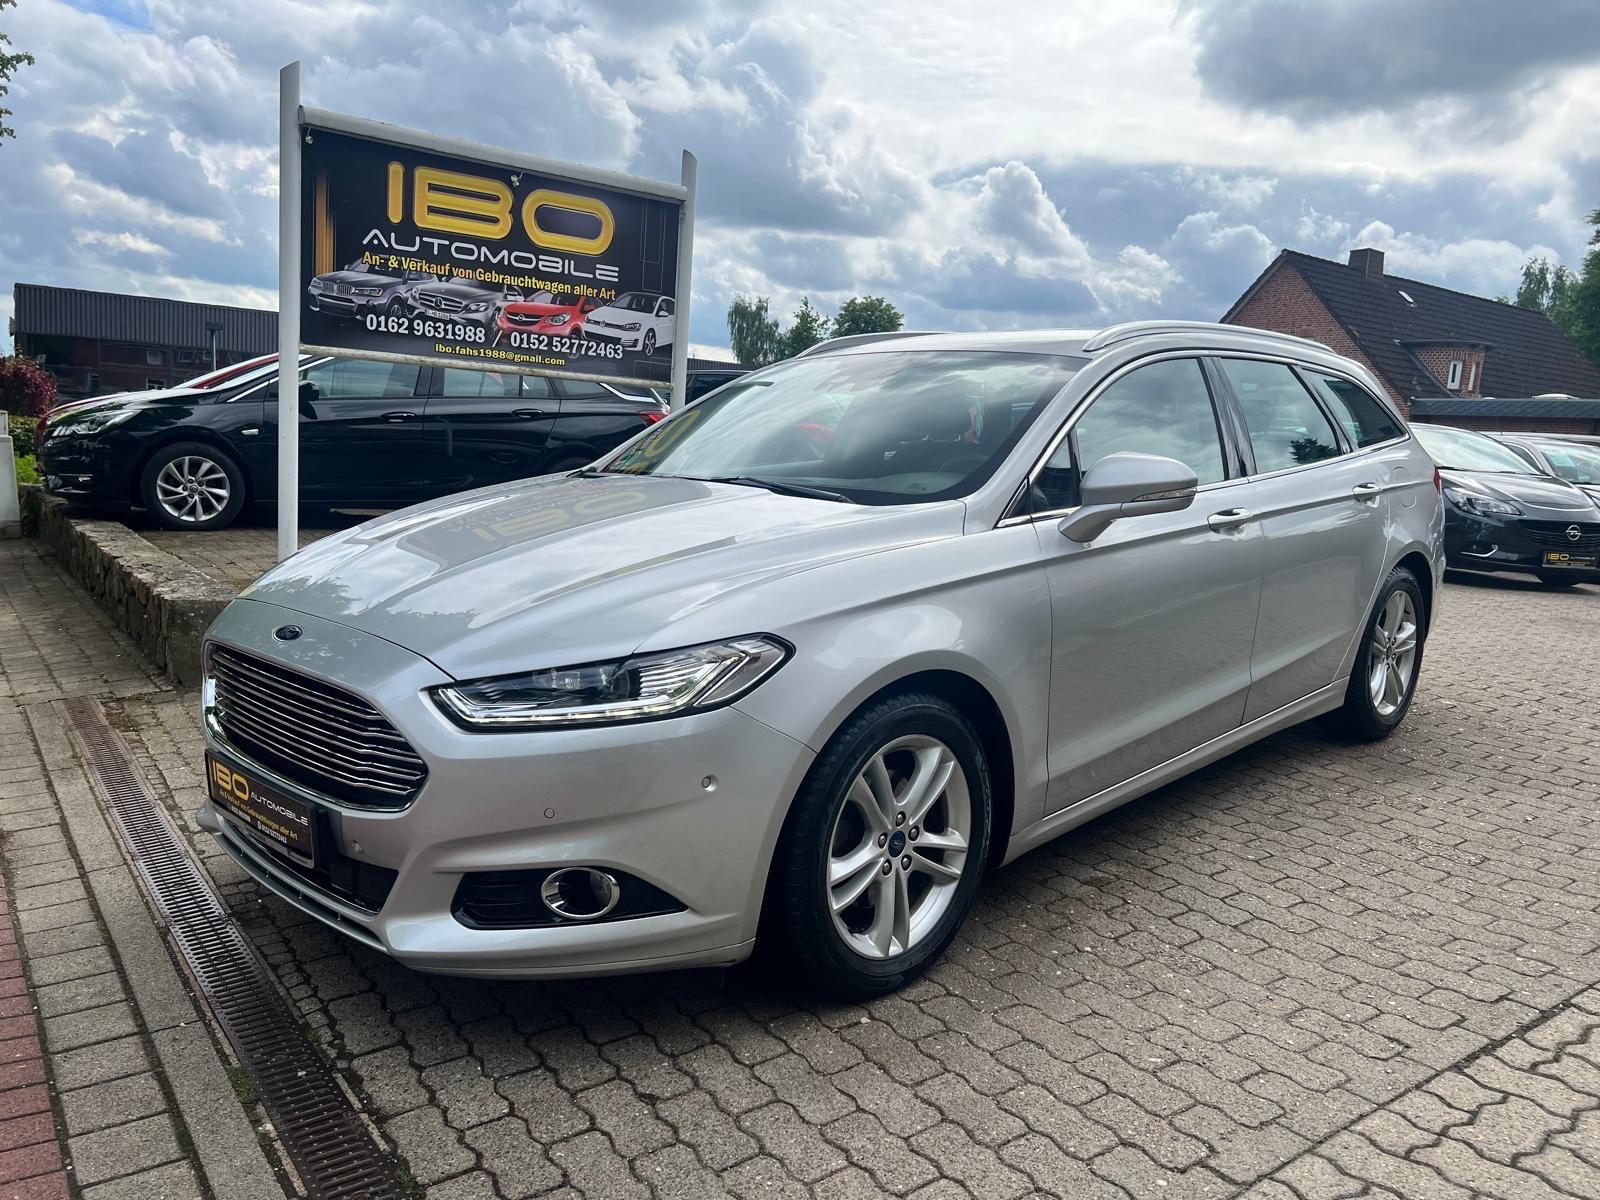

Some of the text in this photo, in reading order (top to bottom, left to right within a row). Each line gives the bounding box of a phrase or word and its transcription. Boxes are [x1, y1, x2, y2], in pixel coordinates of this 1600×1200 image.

[387, 161, 615, 256] IBO
[362, 228, 619, 282] AUTOMOBILE
[362, 251, 616, 300] An- & Verkauf von Gebrauchtwagen aller Art
[366, 313, 409, 334] 0162
[413, 319, 486, 343] 9631988
[510, 331, 548, 351] 0152
[552, 336, 623, 359] 52772463
[212, 760, 249, 801] IBO
[250, 791, 309, 826] AUTOMOBILE
